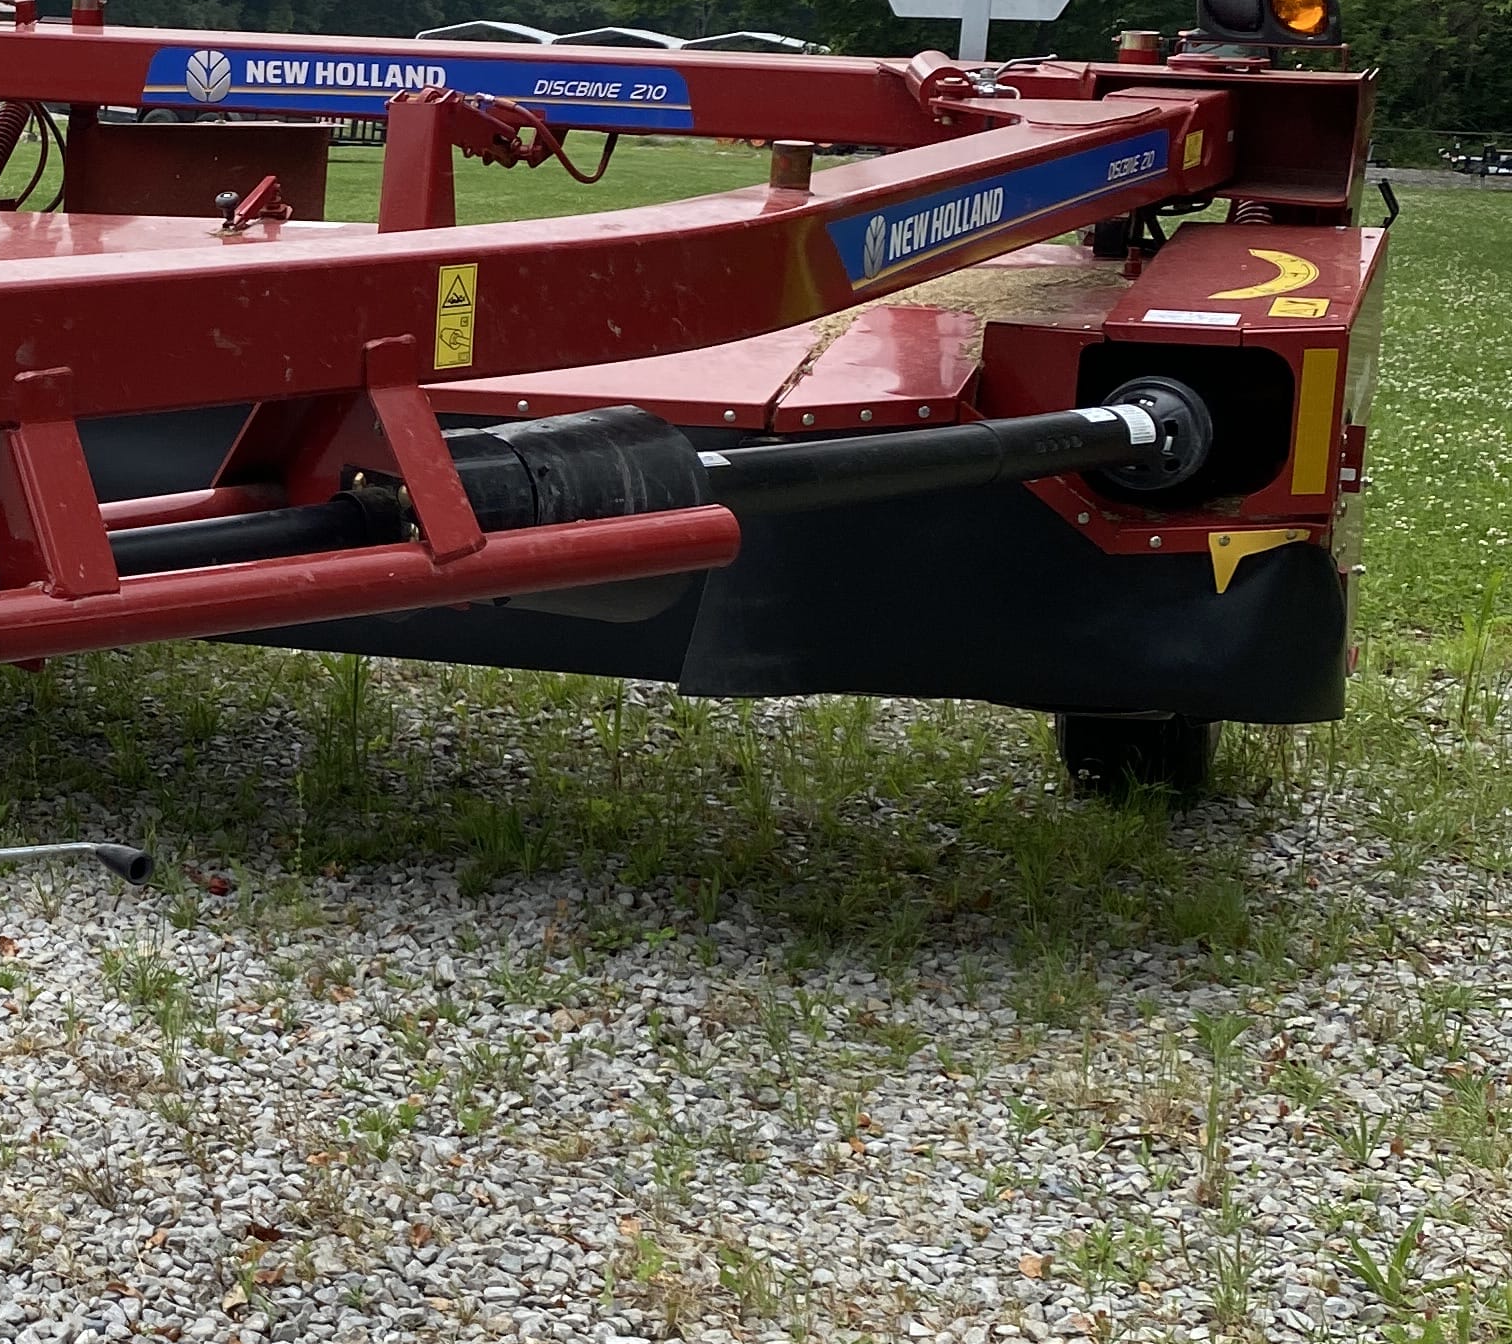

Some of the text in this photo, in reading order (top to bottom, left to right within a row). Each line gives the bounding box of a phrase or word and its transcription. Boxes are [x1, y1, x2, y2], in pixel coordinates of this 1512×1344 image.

[246, 60, 446, 89] NEW HOLLAND
[533, 79, 667, 100] DISCBINE 210
[888, 187, 1004, 261] NEW HOLLAND
